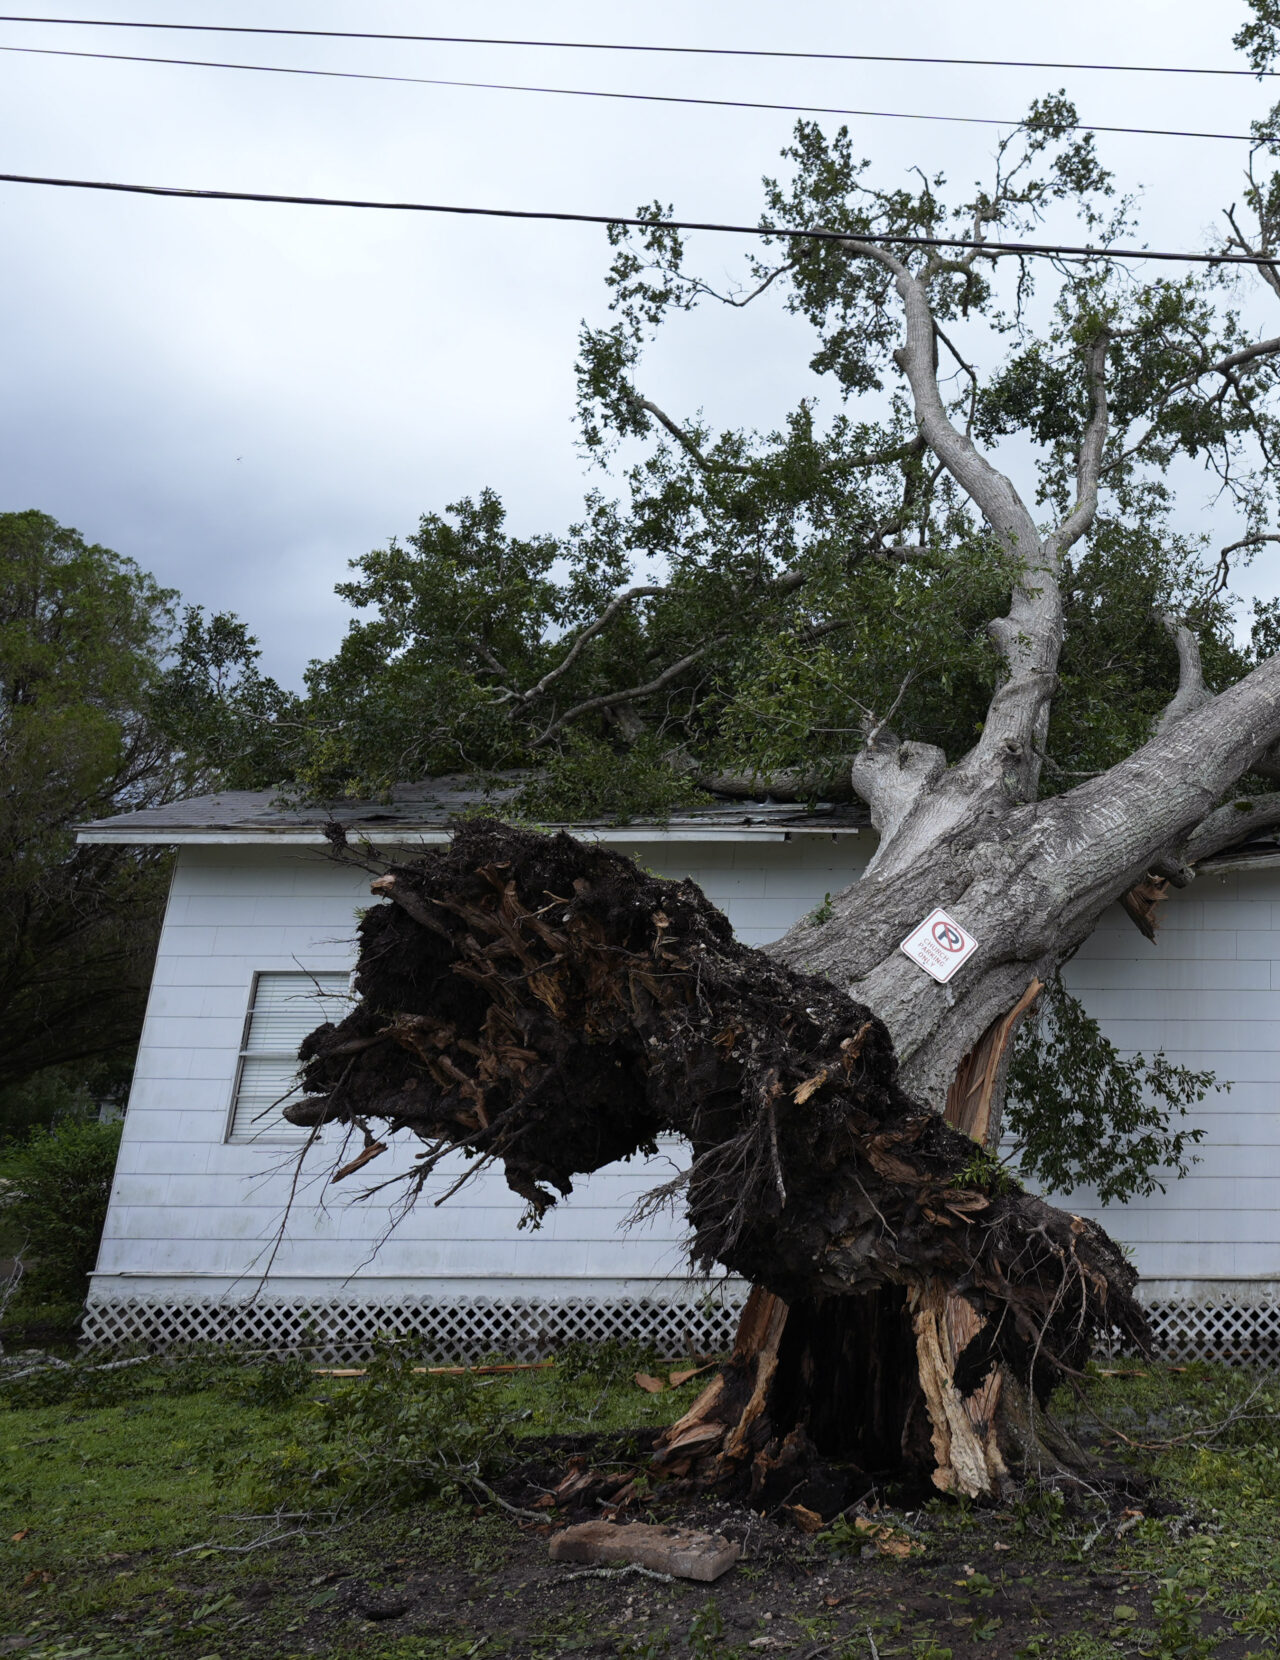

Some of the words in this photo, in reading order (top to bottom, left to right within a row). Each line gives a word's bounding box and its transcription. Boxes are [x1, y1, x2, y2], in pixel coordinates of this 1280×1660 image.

[918, 943, 945, 967] PARKING
[918, 952, 935, 967] ONLY
[923, 938, 950, 961] CHURCH
